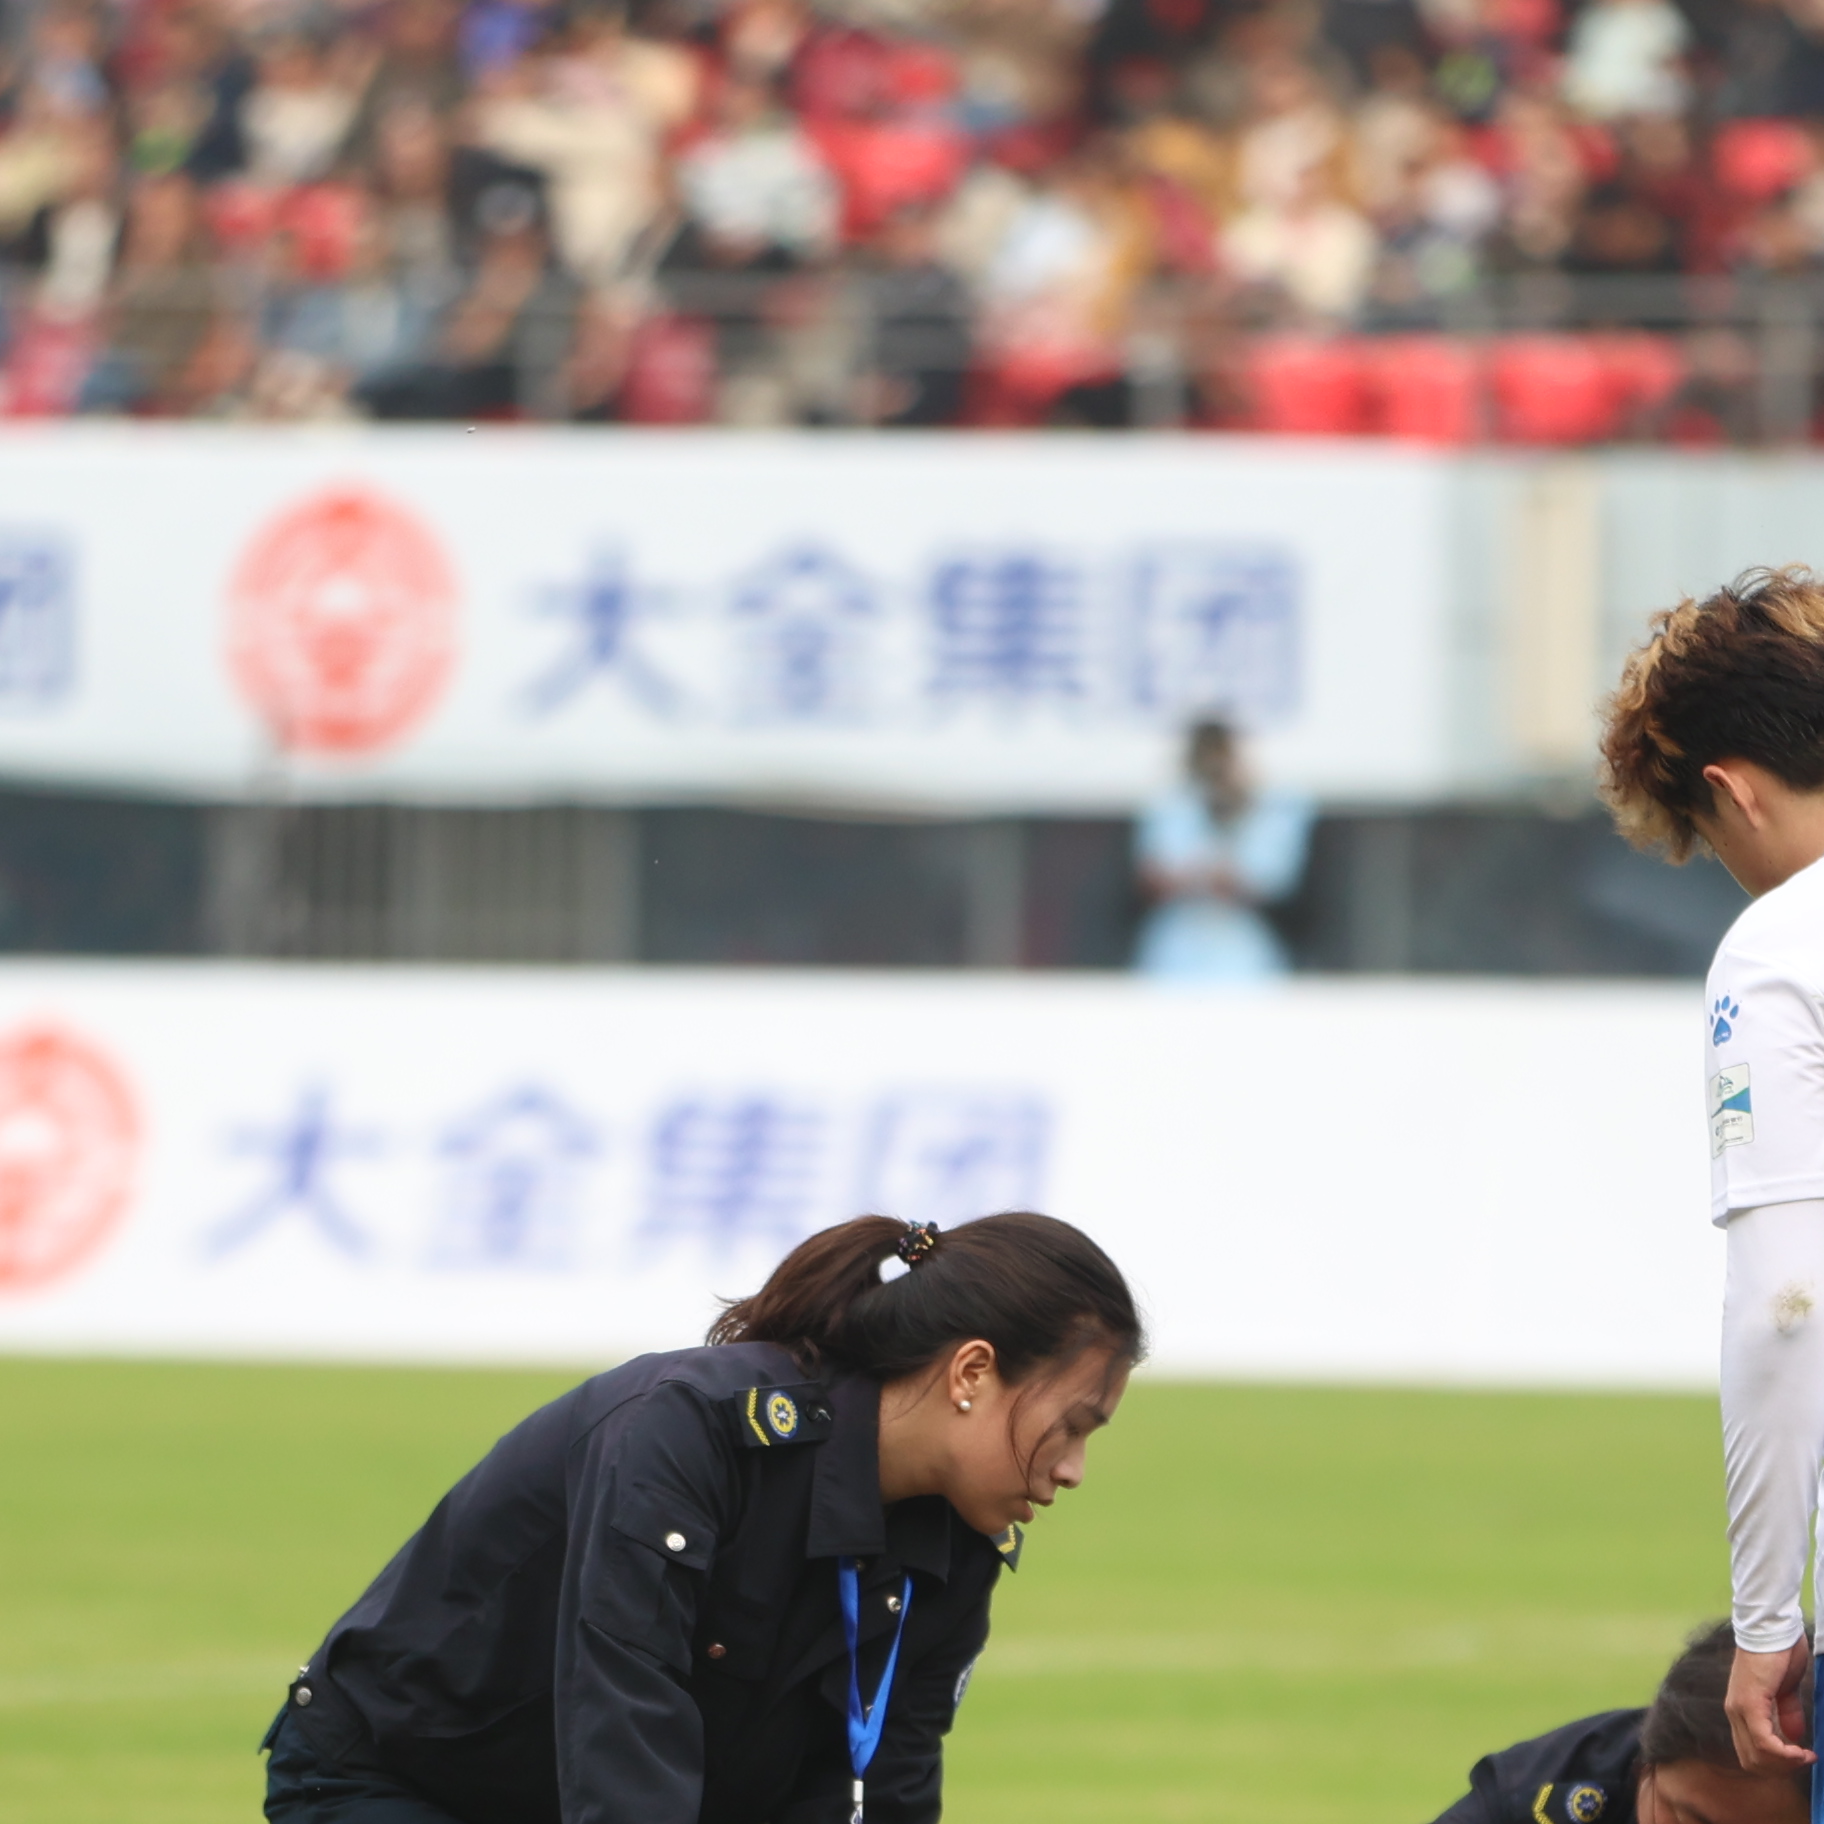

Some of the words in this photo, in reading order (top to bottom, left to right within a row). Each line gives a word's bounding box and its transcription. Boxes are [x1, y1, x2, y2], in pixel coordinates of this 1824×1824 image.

[508, 530, 1312, 732] 大全集团
[186, 1073, 1058, 1274] 大全集团
